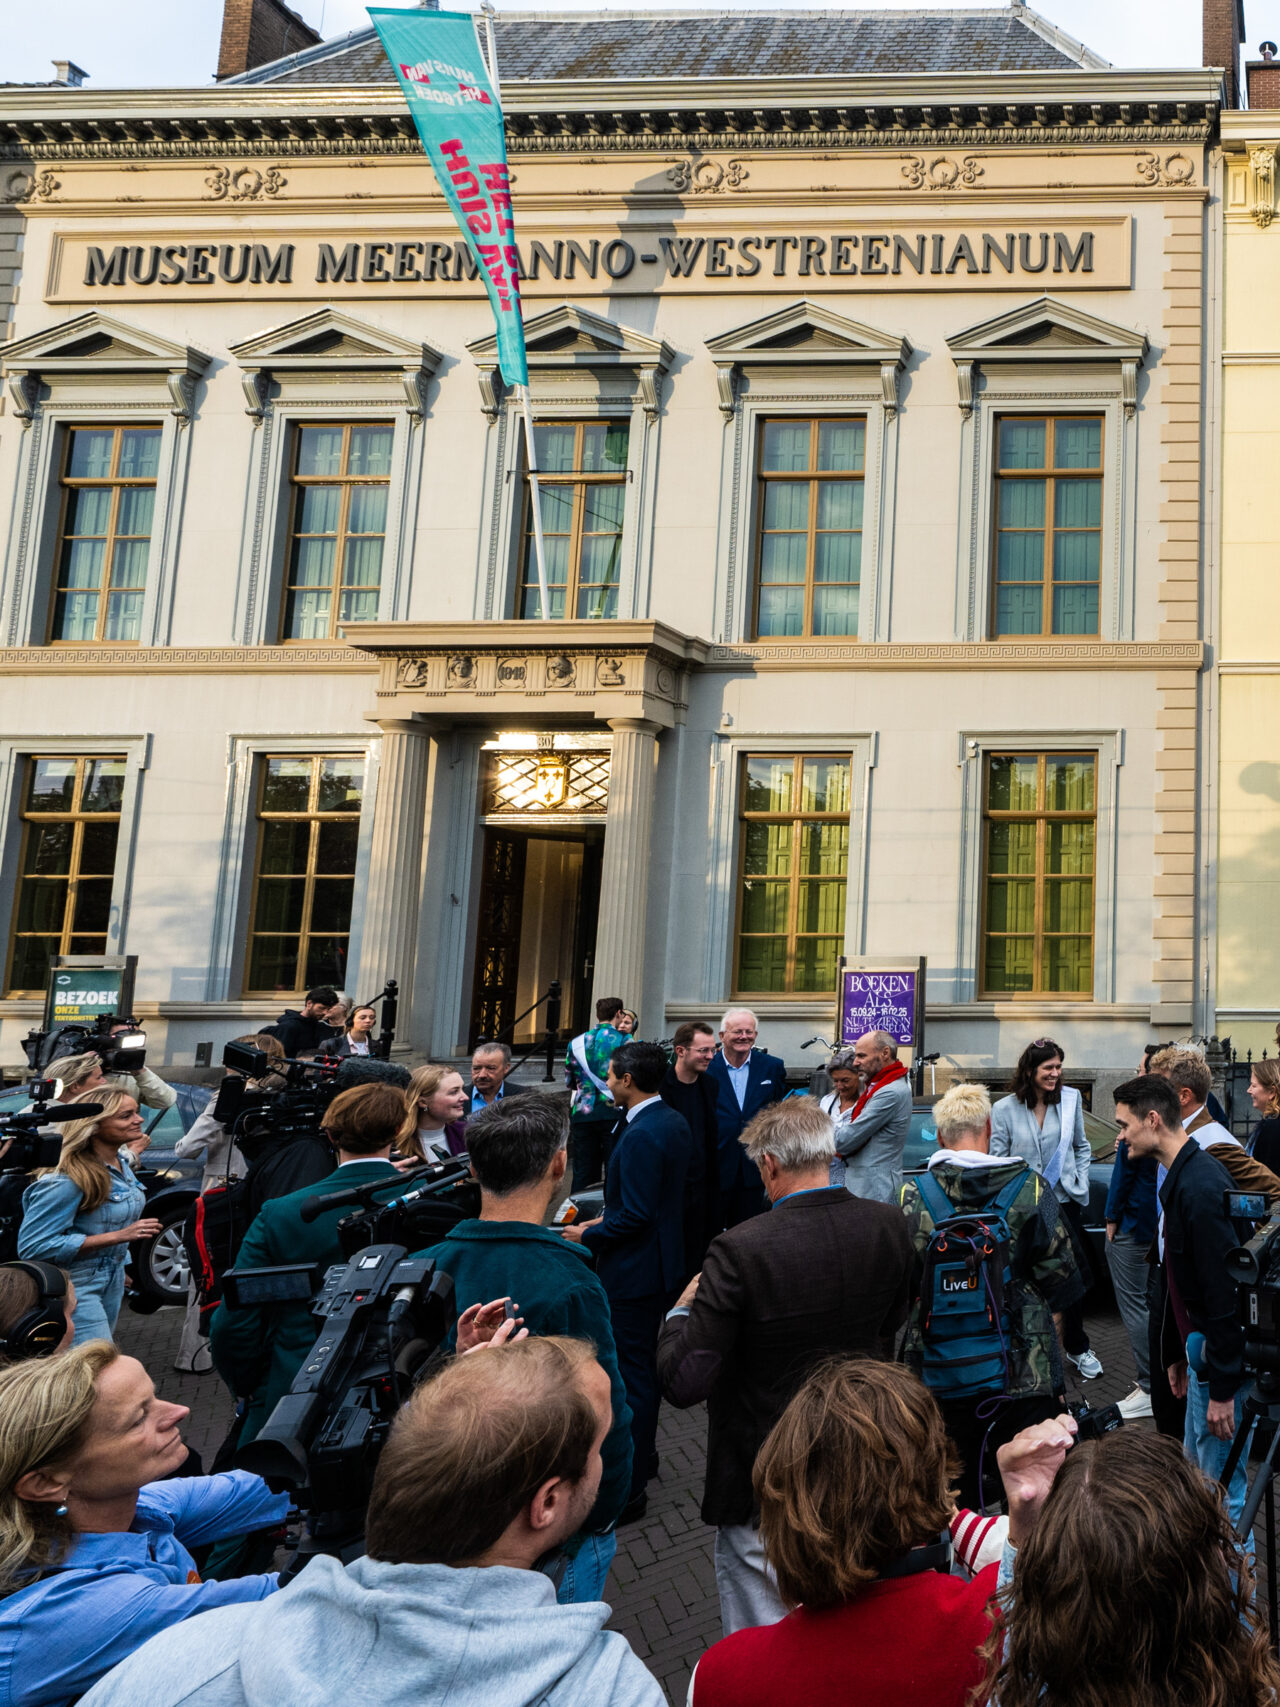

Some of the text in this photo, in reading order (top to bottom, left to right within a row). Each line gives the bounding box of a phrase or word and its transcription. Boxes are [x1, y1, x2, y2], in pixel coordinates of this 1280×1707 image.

[83, 243, 294, 286] MUSEUM
[850, 975, 909, 992] BOEKEN
[55, 991, 118, 1005] BEZOEK
[55, 1006, 79, 1014] ONZE
[943, 1276, 977, 1291] LiveU
